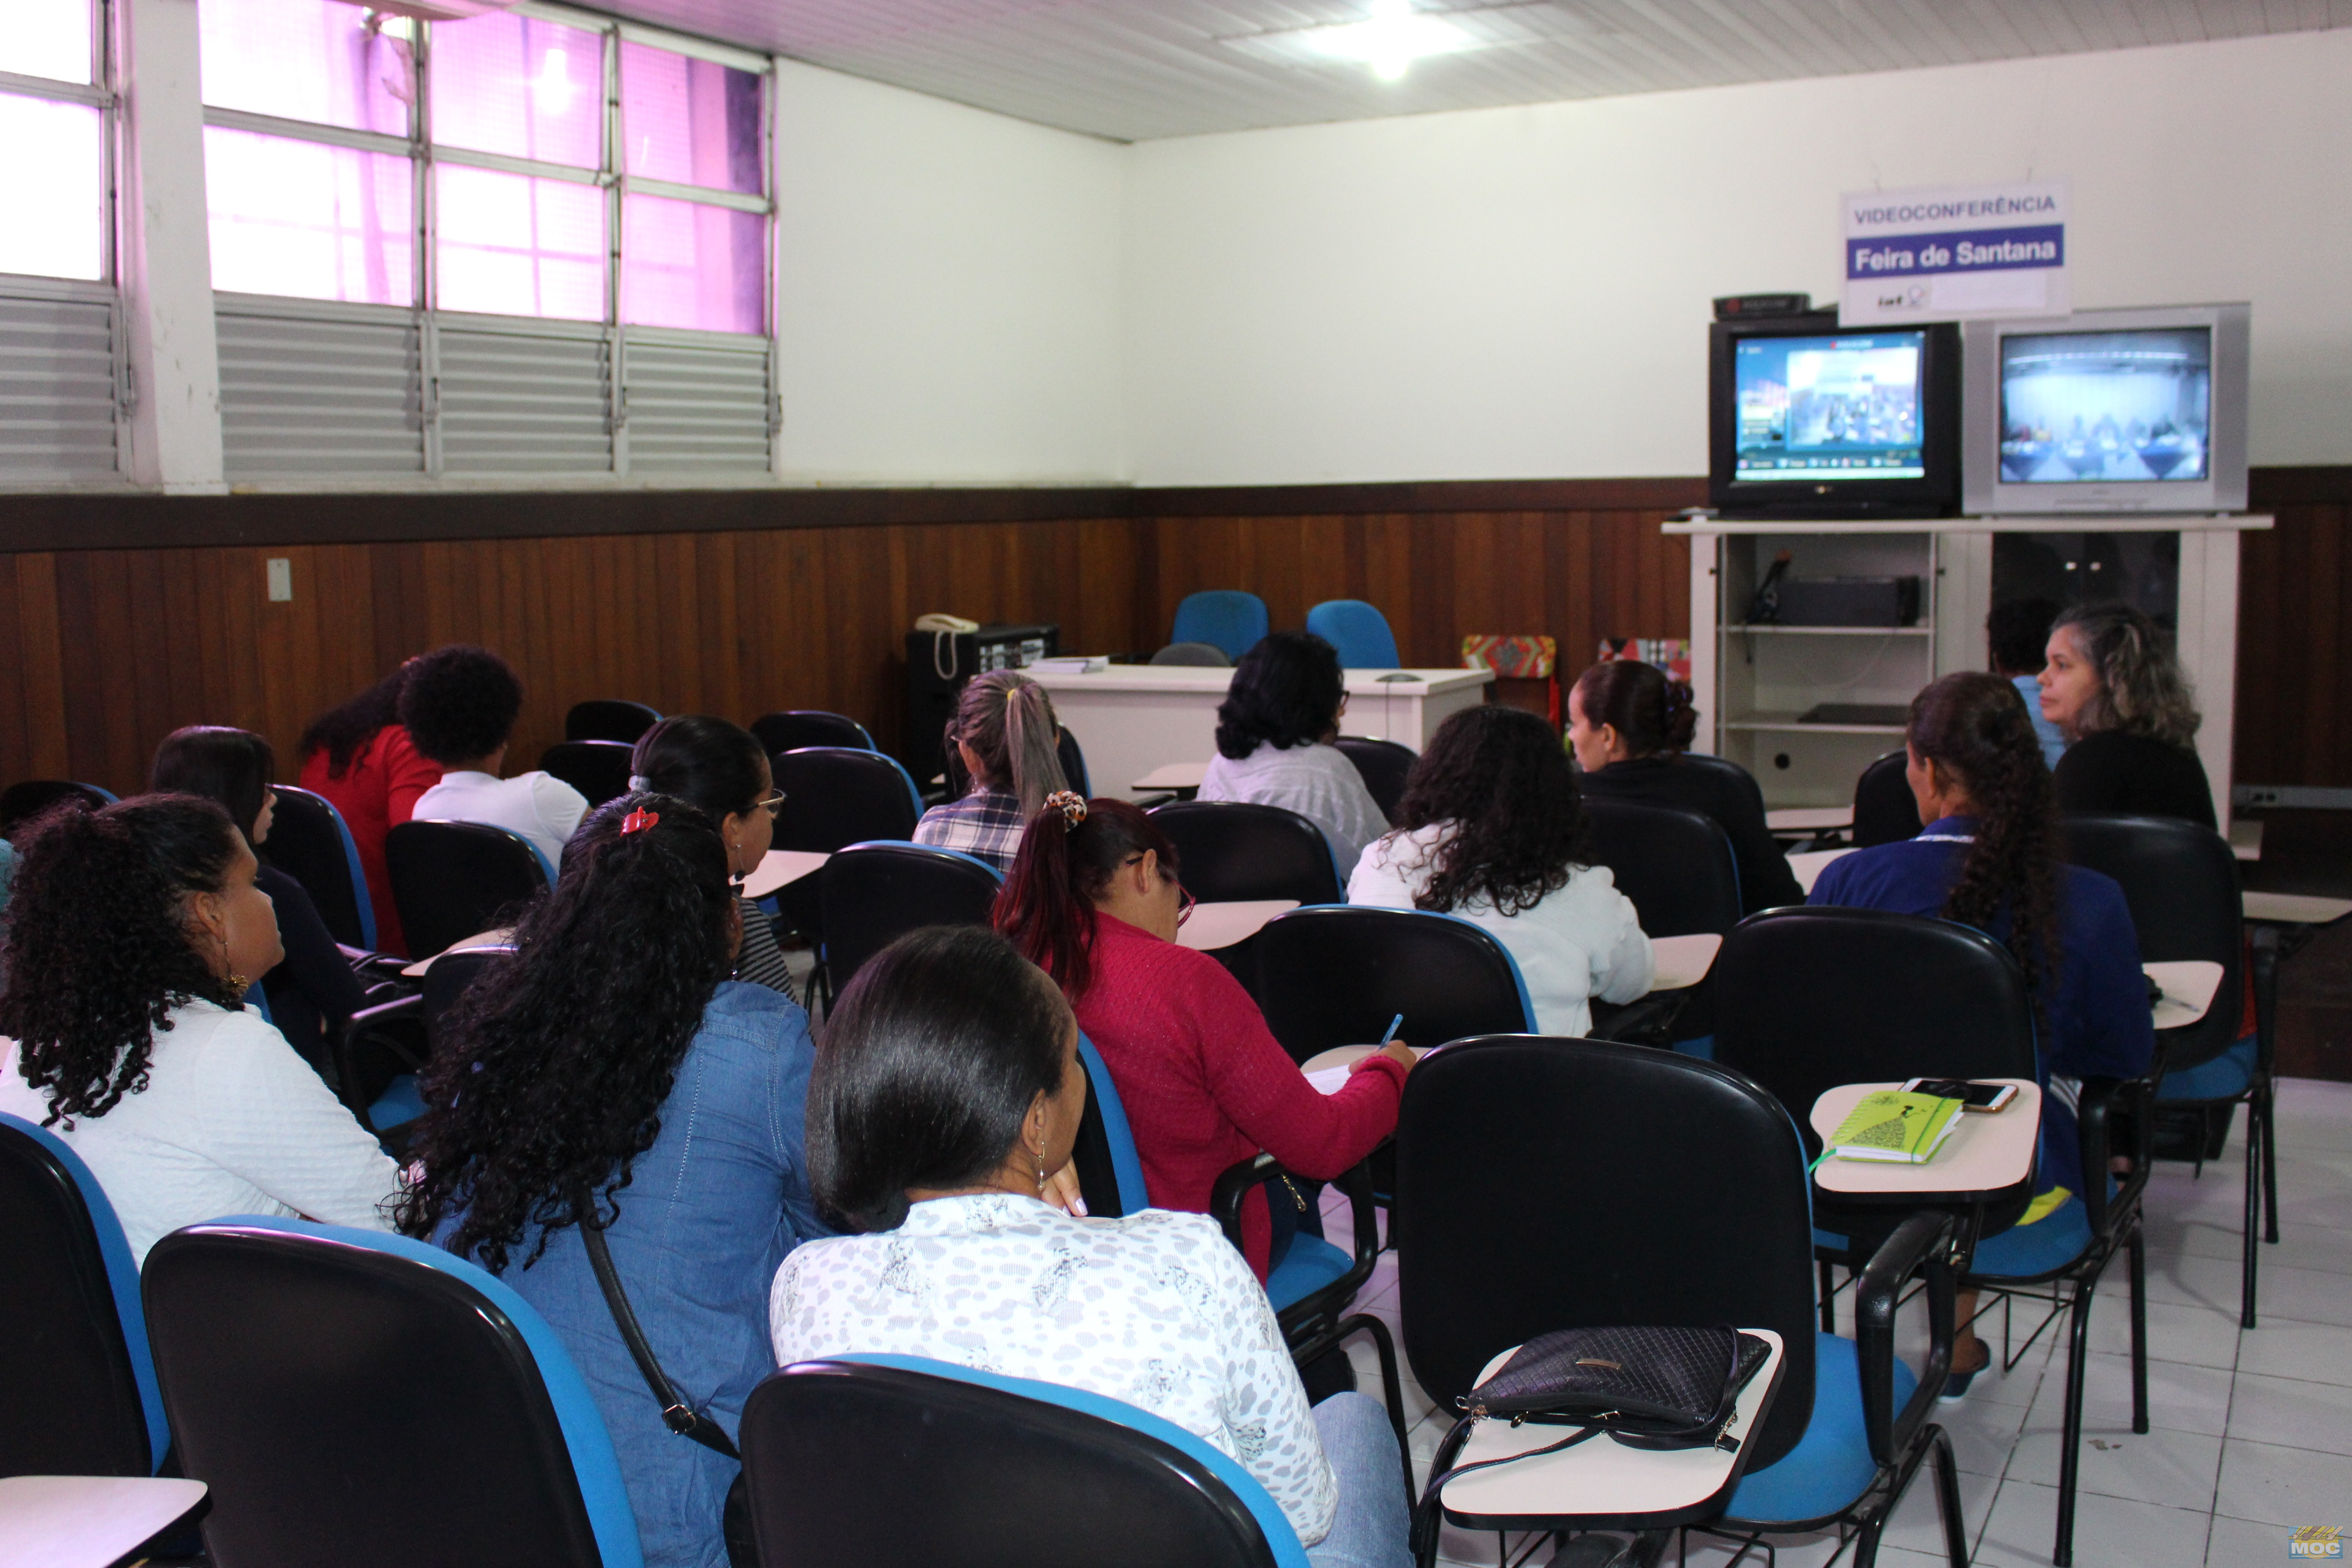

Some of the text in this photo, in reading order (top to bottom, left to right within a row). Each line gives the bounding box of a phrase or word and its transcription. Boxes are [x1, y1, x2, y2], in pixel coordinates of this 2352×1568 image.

[1854, 195, 2055, 224] VIDEOCONFERÊNCIA
[1855, 239, 2057, 271] Feira de Santana
